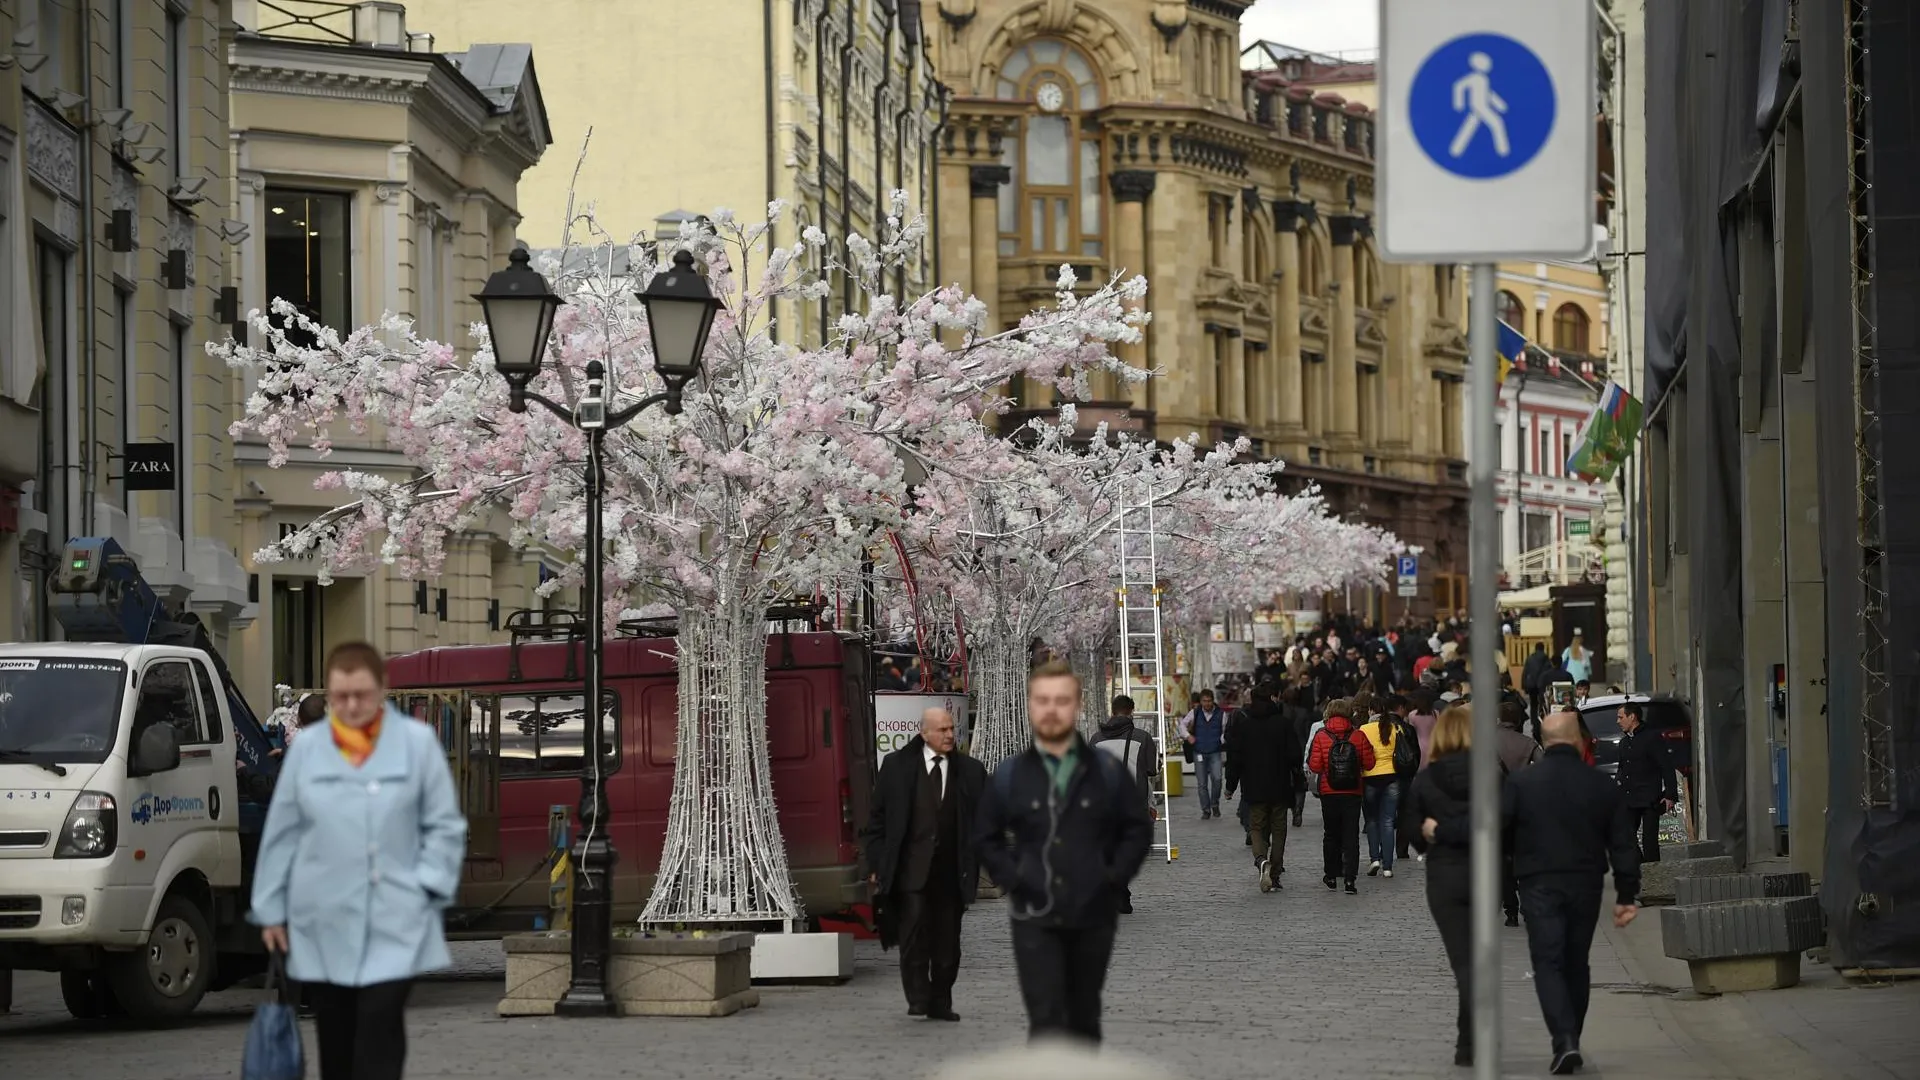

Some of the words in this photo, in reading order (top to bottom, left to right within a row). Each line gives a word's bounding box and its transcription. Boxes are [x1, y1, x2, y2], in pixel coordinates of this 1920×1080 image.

[129, 461, 171, 472] ZARA
[1403, 559, 1414, 574] P
[876, 721, 920, 731] СКОВСК
[153, 796, 205, 816] ДорФронтъ
